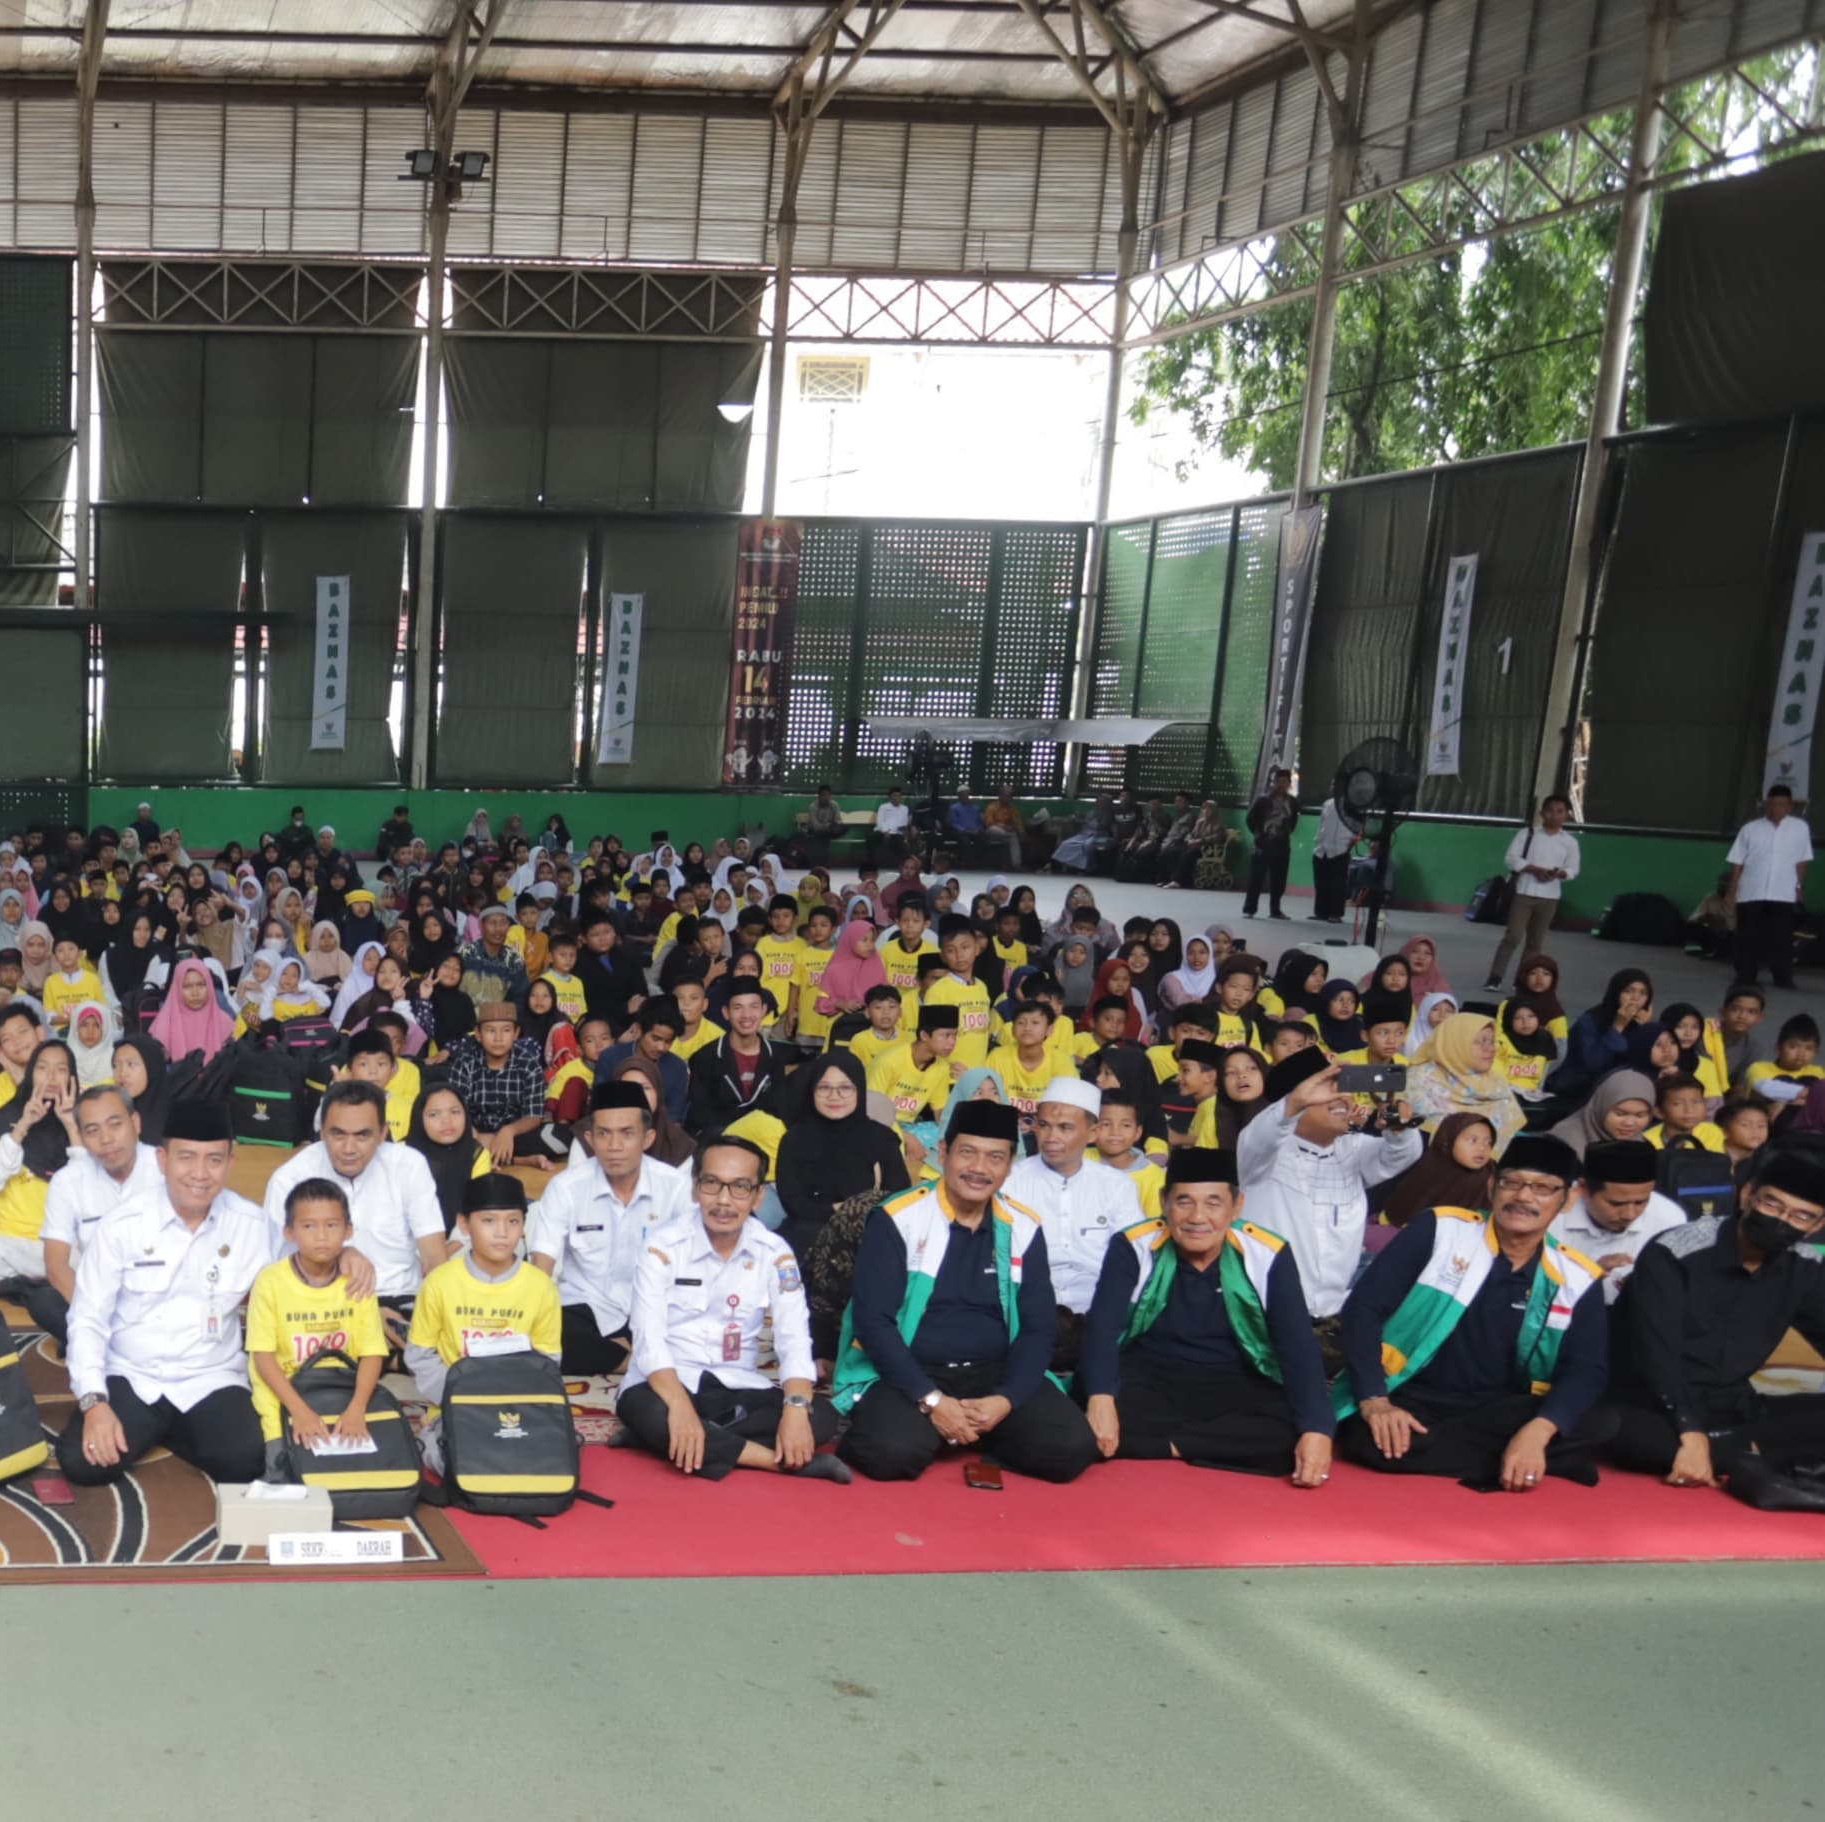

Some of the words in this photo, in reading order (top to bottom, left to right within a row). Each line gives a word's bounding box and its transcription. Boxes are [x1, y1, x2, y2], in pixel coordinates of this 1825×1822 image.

[739, 602, 778, 615] PEMILU
[738, 618, 766, 630] 2024
[326, 583, 340, 700] BAZNAS
[1441, 564, 1469, 713] BAZNAS
[616, 601, 632, 715] BAZNAS
[736, 649, 782, 663] RABU
[1497, 637, 1512, 674] 1
[745, 665, 769, 693] 14
[735, 707, 775, 719] 2024
[286, 1311, 317, 1322] BUKA
